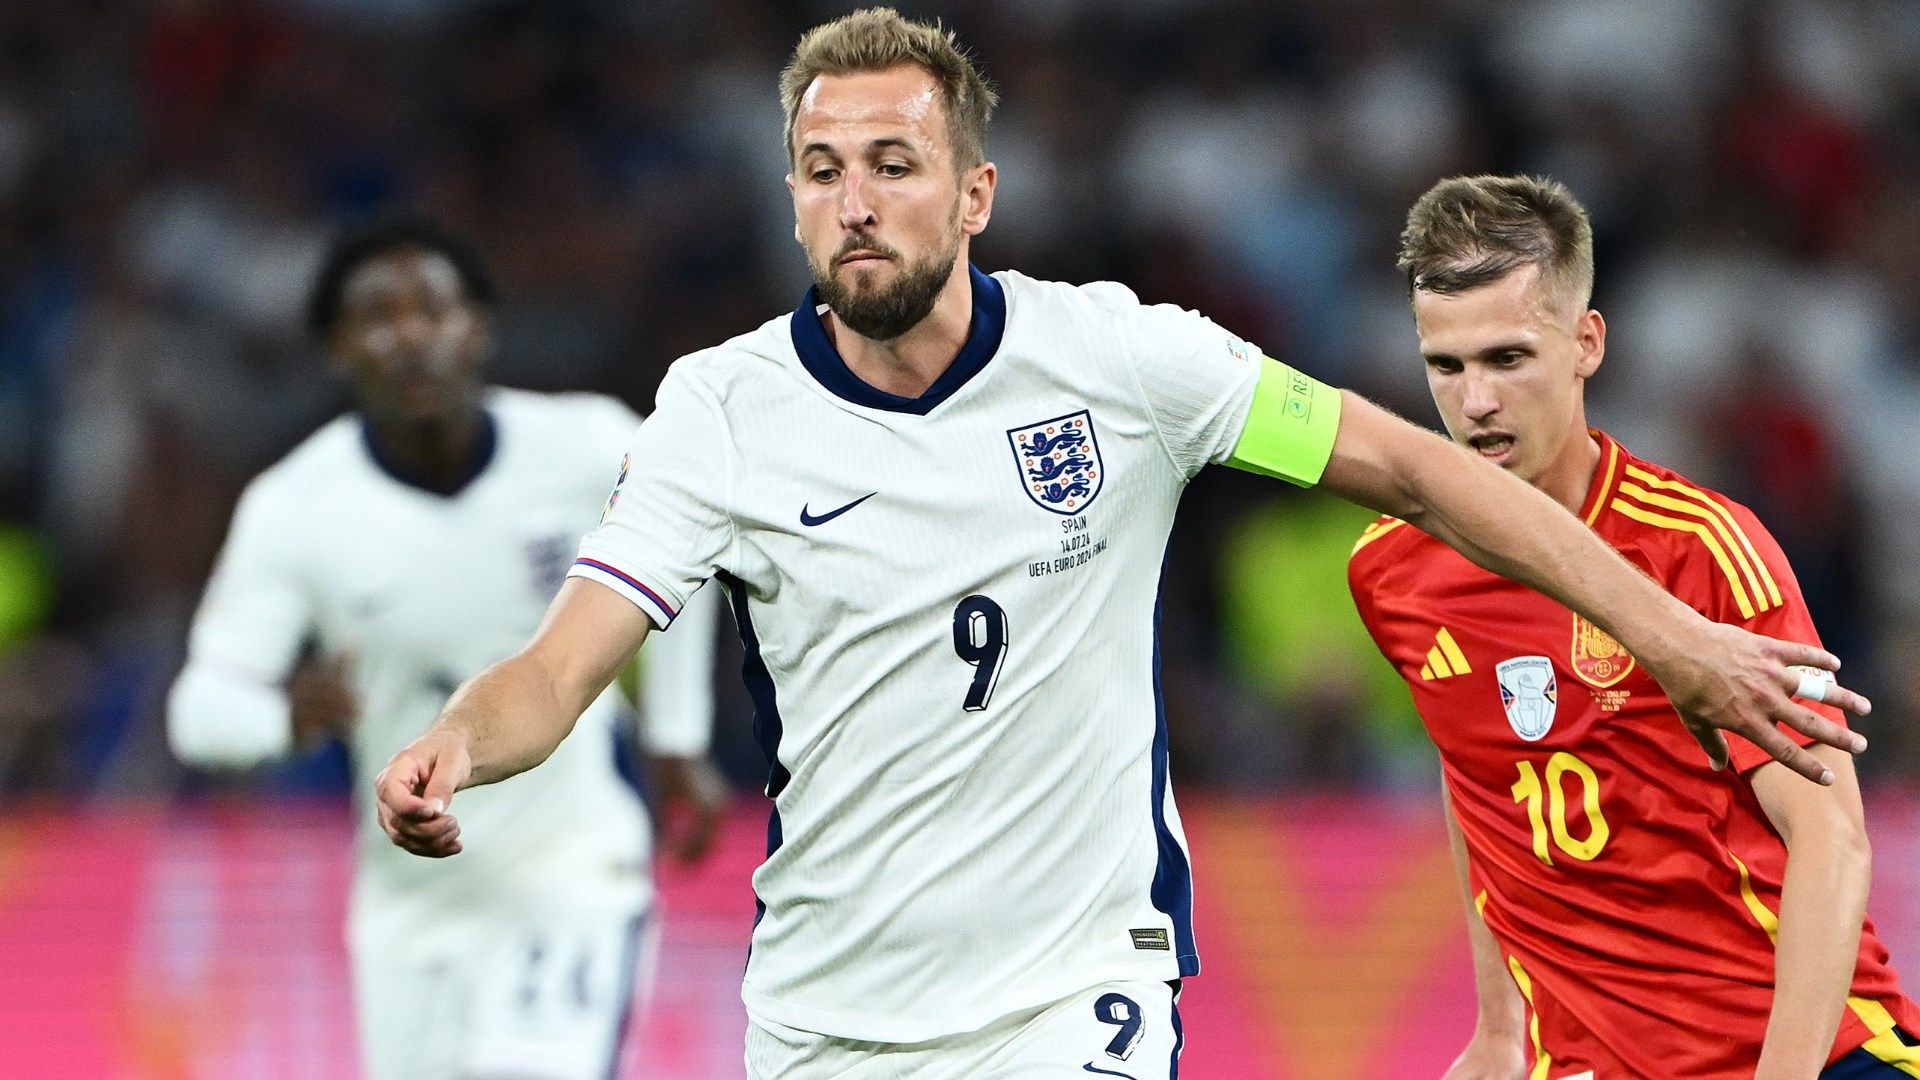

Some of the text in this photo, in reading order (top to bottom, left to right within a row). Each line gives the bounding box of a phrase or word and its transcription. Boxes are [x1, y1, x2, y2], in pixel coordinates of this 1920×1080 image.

[1060, 532, 1091, 553] 14.07.24
[1061, 516, 1087, 533] SPAIN
[1028, 537, 1108, 578] UEFA EURO 2024 FINAL
[953, 594, 1009, 712] 9
[1511, 751, 1610, 867] 10
[1093, 992, 1146, 1062] 9
